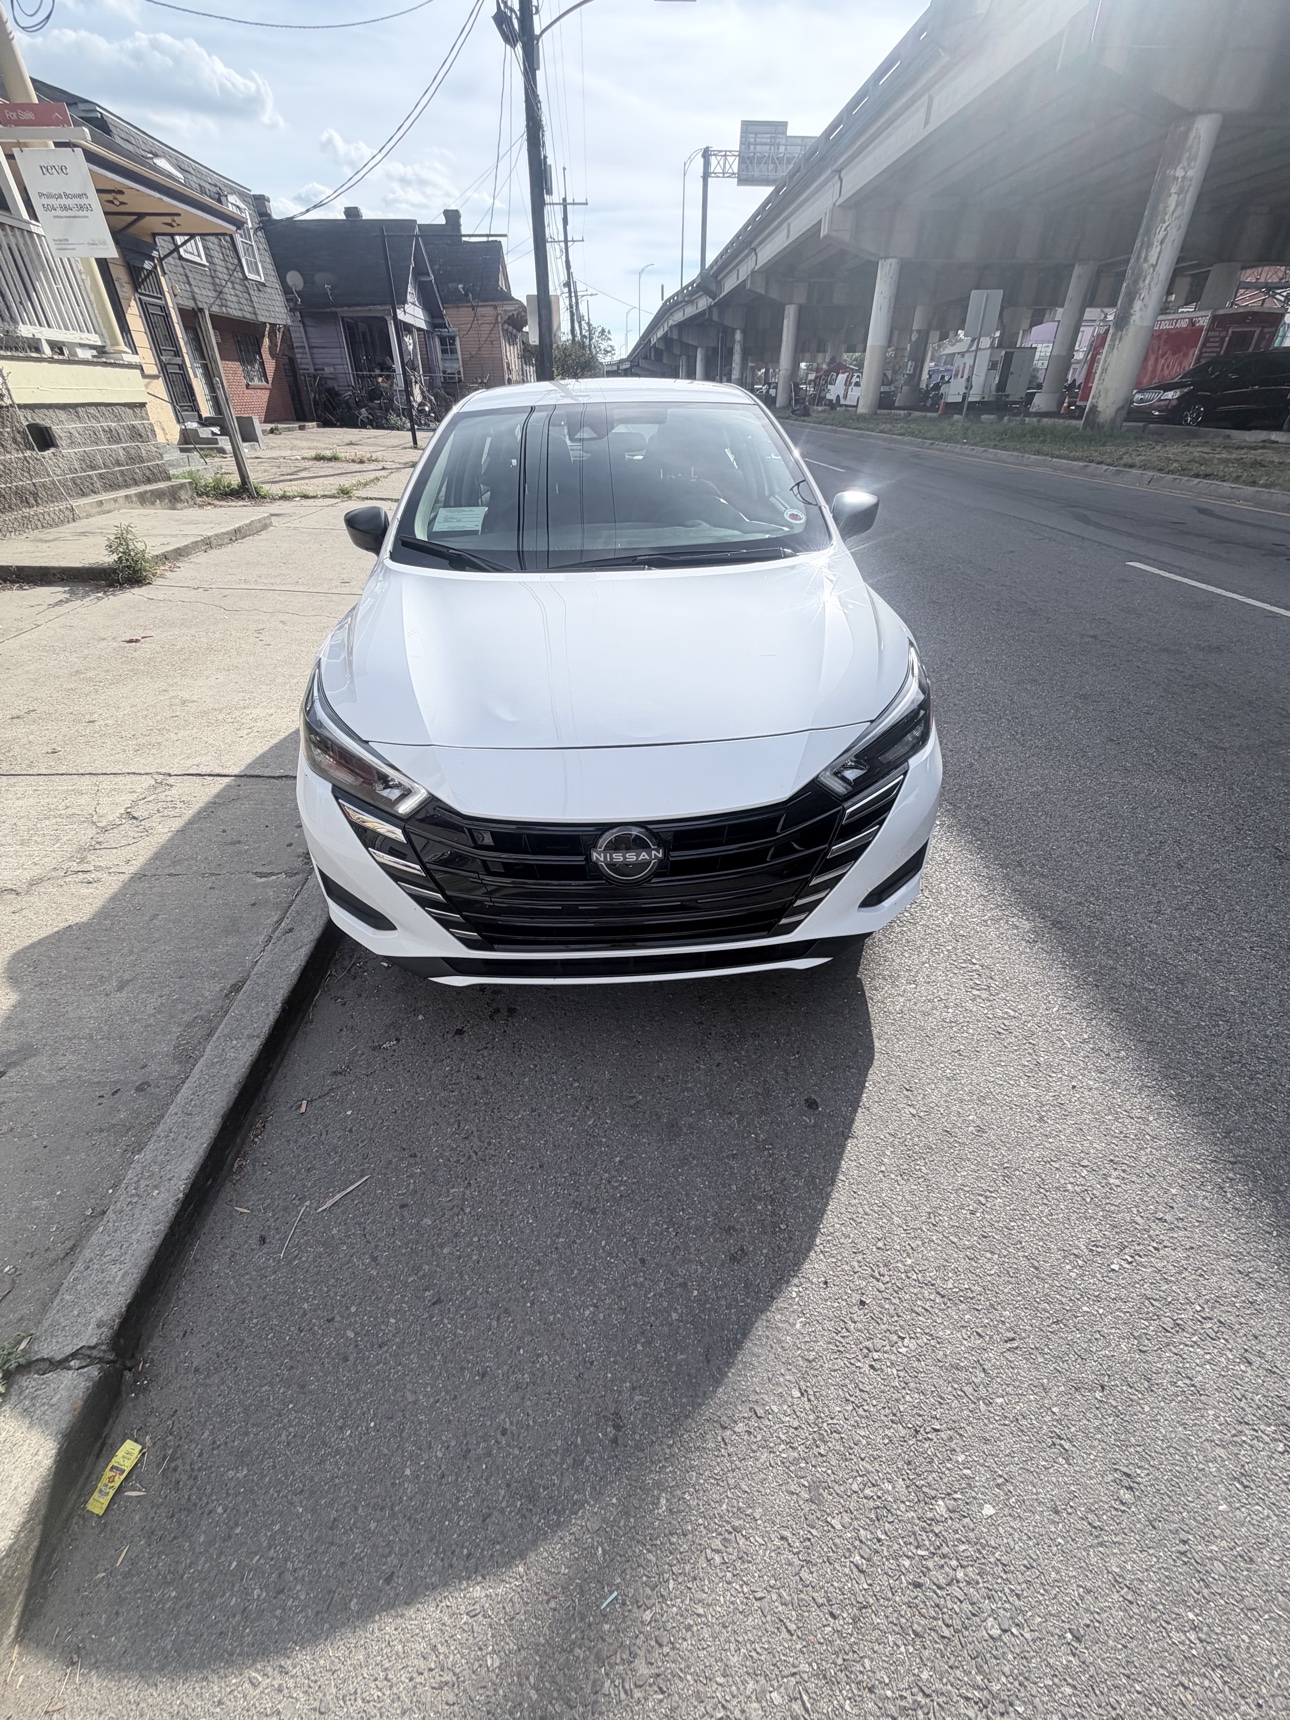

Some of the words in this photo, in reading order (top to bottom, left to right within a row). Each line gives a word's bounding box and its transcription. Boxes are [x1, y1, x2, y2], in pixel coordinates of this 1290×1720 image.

[4, 109, 17, 120] For
[17, 109, 36, 120] Sale
[38, 191, 63, 202] Phillipa
[62, 191, 89, 200] Bowers
[42, 203, 94, 212] 504-884-3893
[1175, 318, 1189, 329] AND
[592, 848, 663, 862] NISSAN
